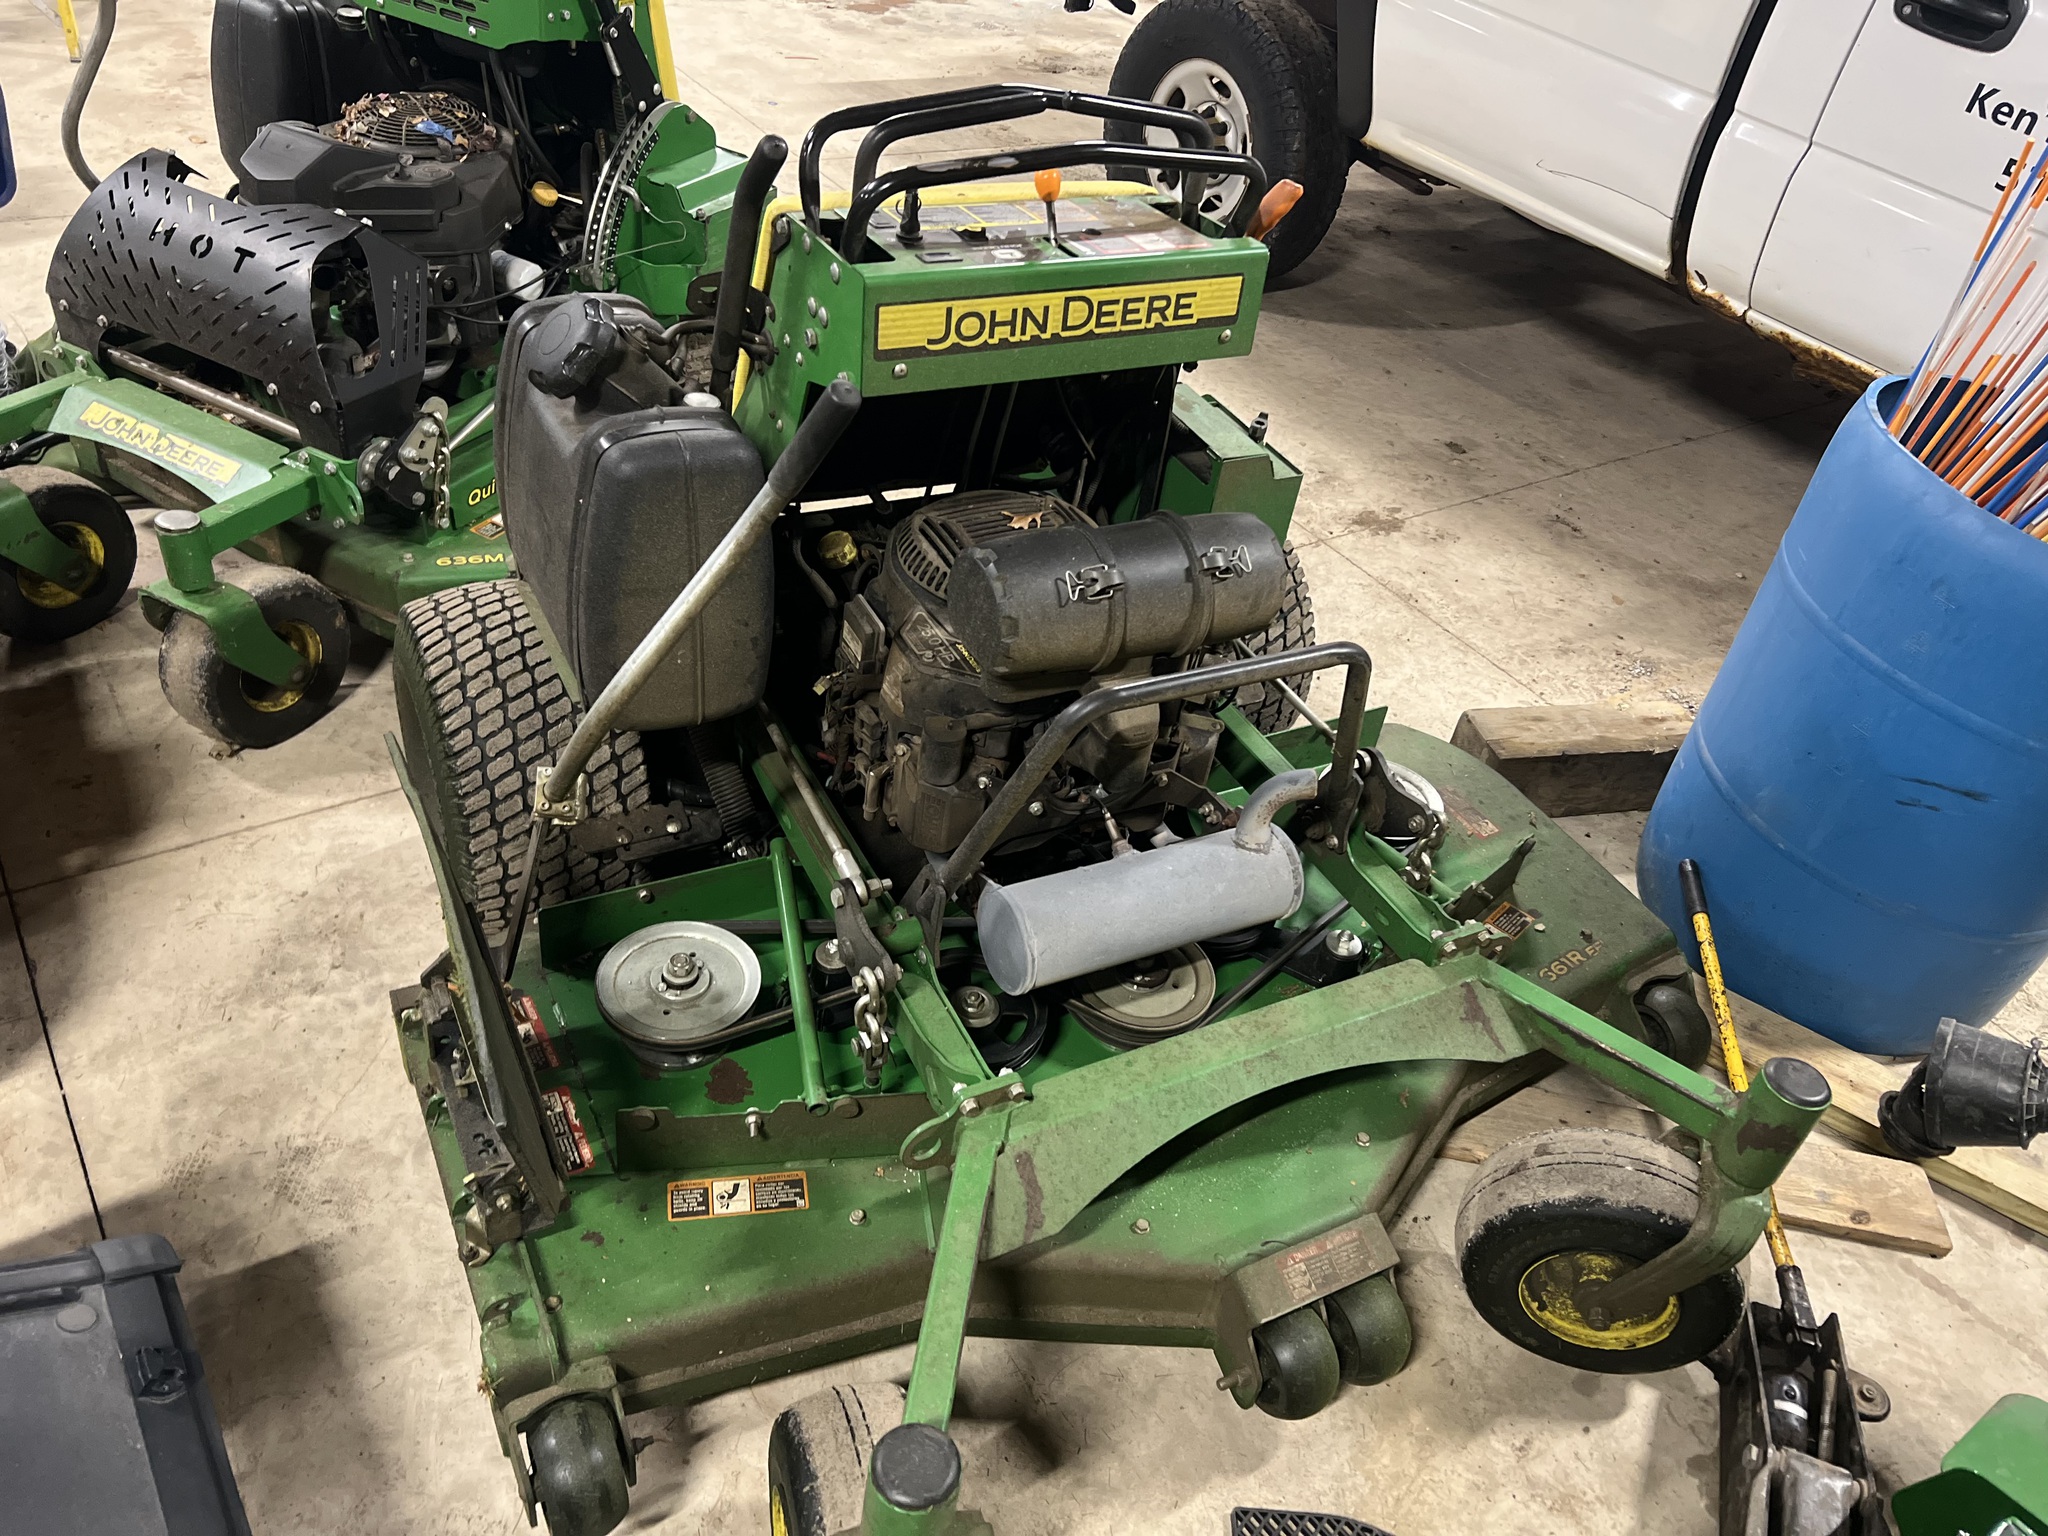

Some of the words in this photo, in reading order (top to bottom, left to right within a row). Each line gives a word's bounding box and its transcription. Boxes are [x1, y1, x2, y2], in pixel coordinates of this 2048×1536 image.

[1965, 82, 2048, 143] Ken
[149, 217, 256, 274] HOT
[926, 304, 1052, 345] JOHN
[1060, 291, 1198, 332] DEERE
[90, 411, 153, 447] JOHN
[152, 436, 225, 478] DEERE
[436, 552, 505, 567] 636M
[934, 645, 956, 662] HP
[763, 1173, 800, 1181] ADVERTENCIA
